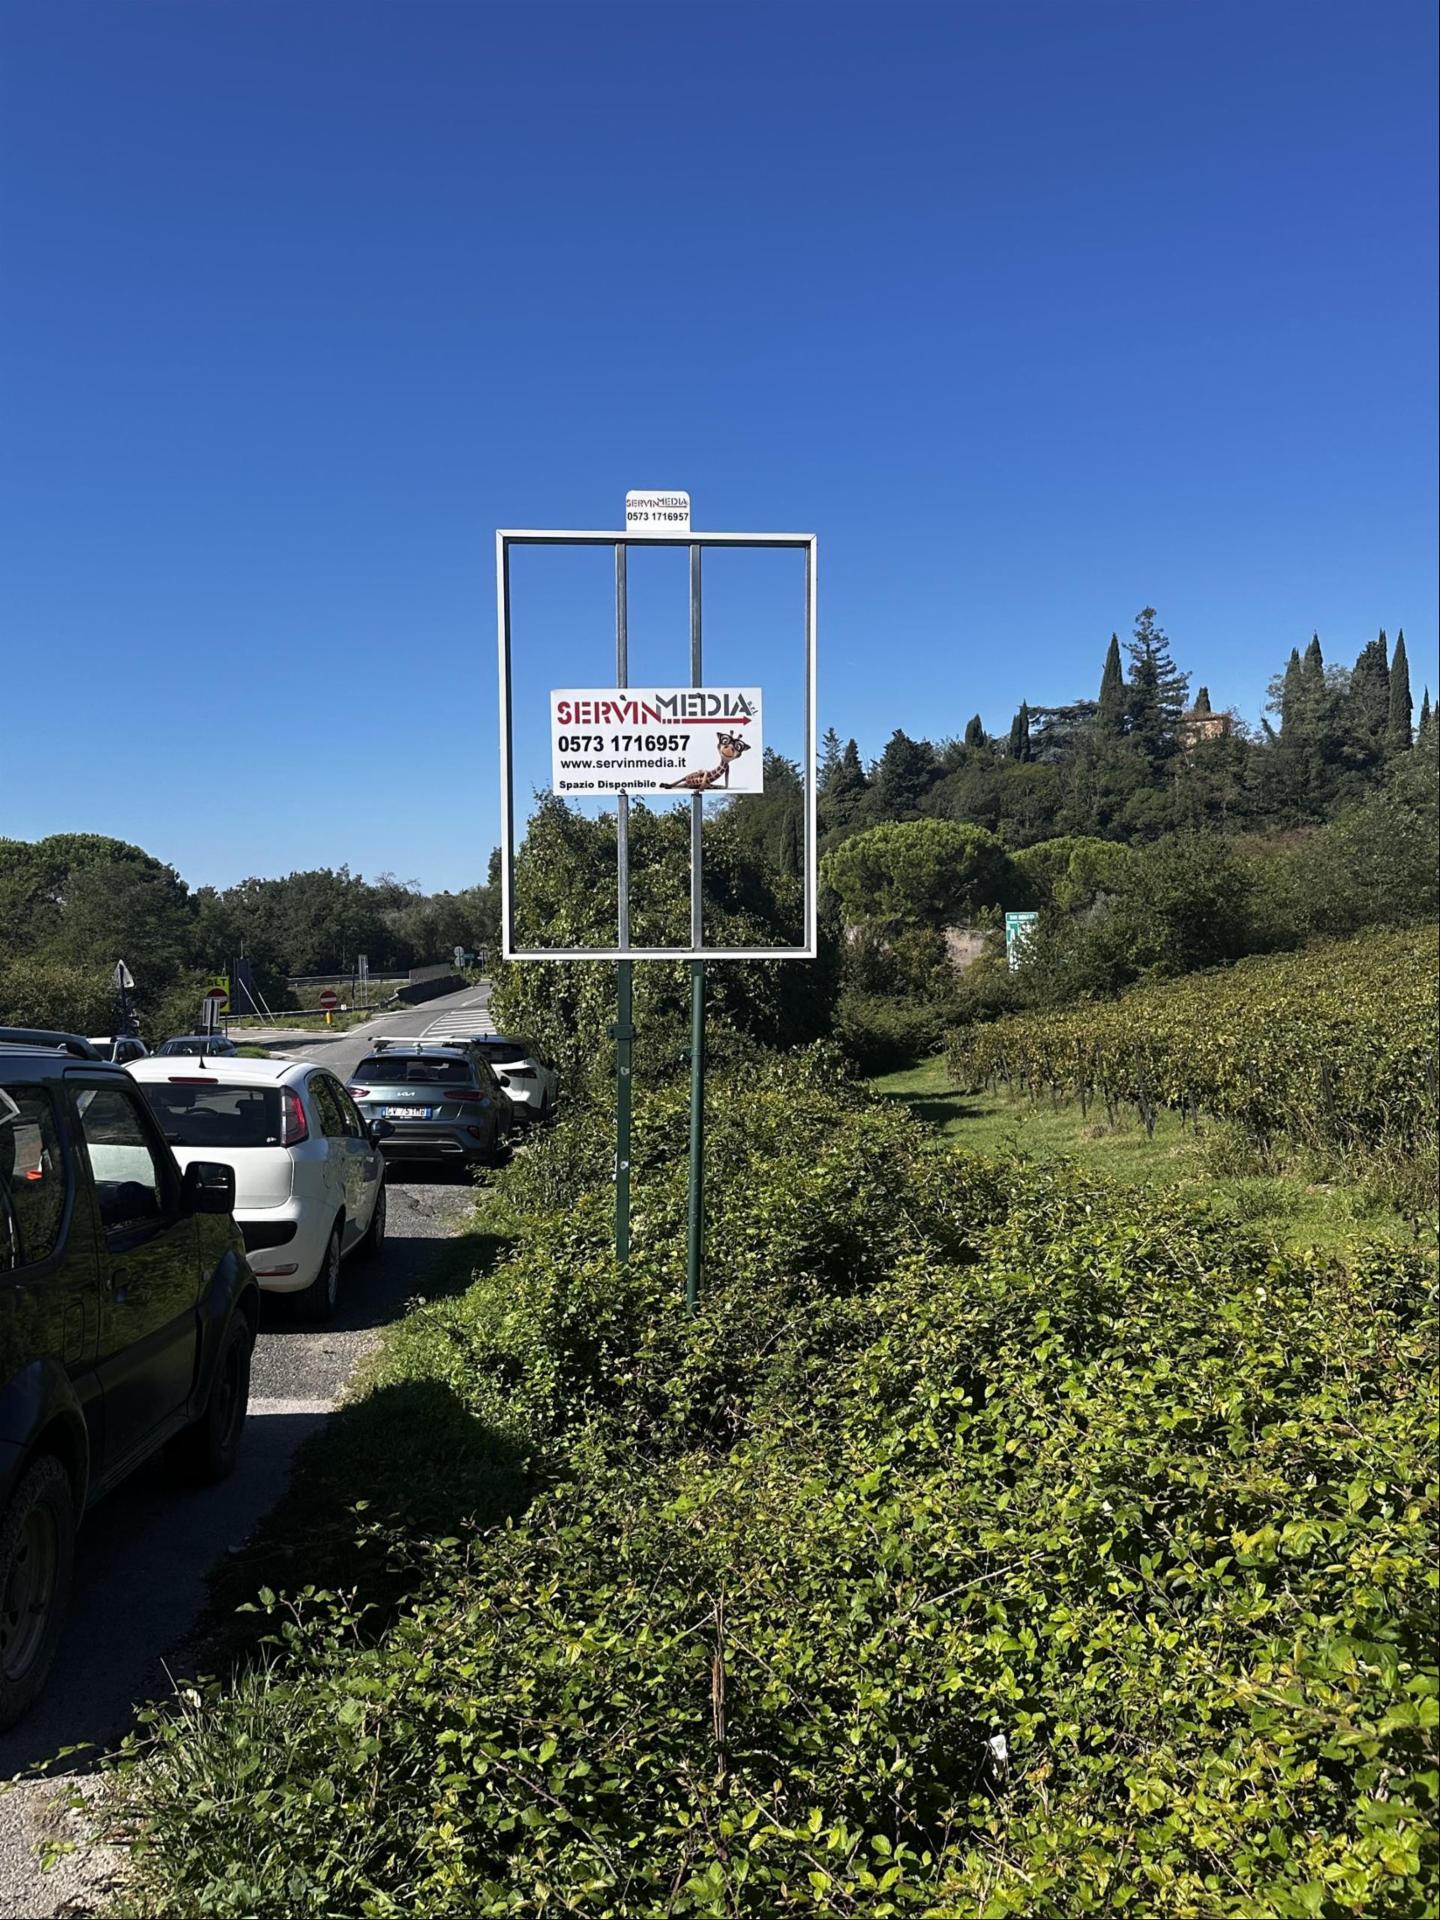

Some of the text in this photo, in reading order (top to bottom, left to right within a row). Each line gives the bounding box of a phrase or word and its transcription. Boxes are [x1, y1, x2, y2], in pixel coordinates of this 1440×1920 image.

[626, 497, 688, 508] SERVINMEDIA
[627, 512, 689, 521] 0573 1716957
[557, 693, 752, 725] SERVINMEDIA
[558, 734, 691, 752] 0573 1716957
[560, 757, 687, 769] www.servinmedia.it
[559, 780, 656, 789] Spazio Disponibile
